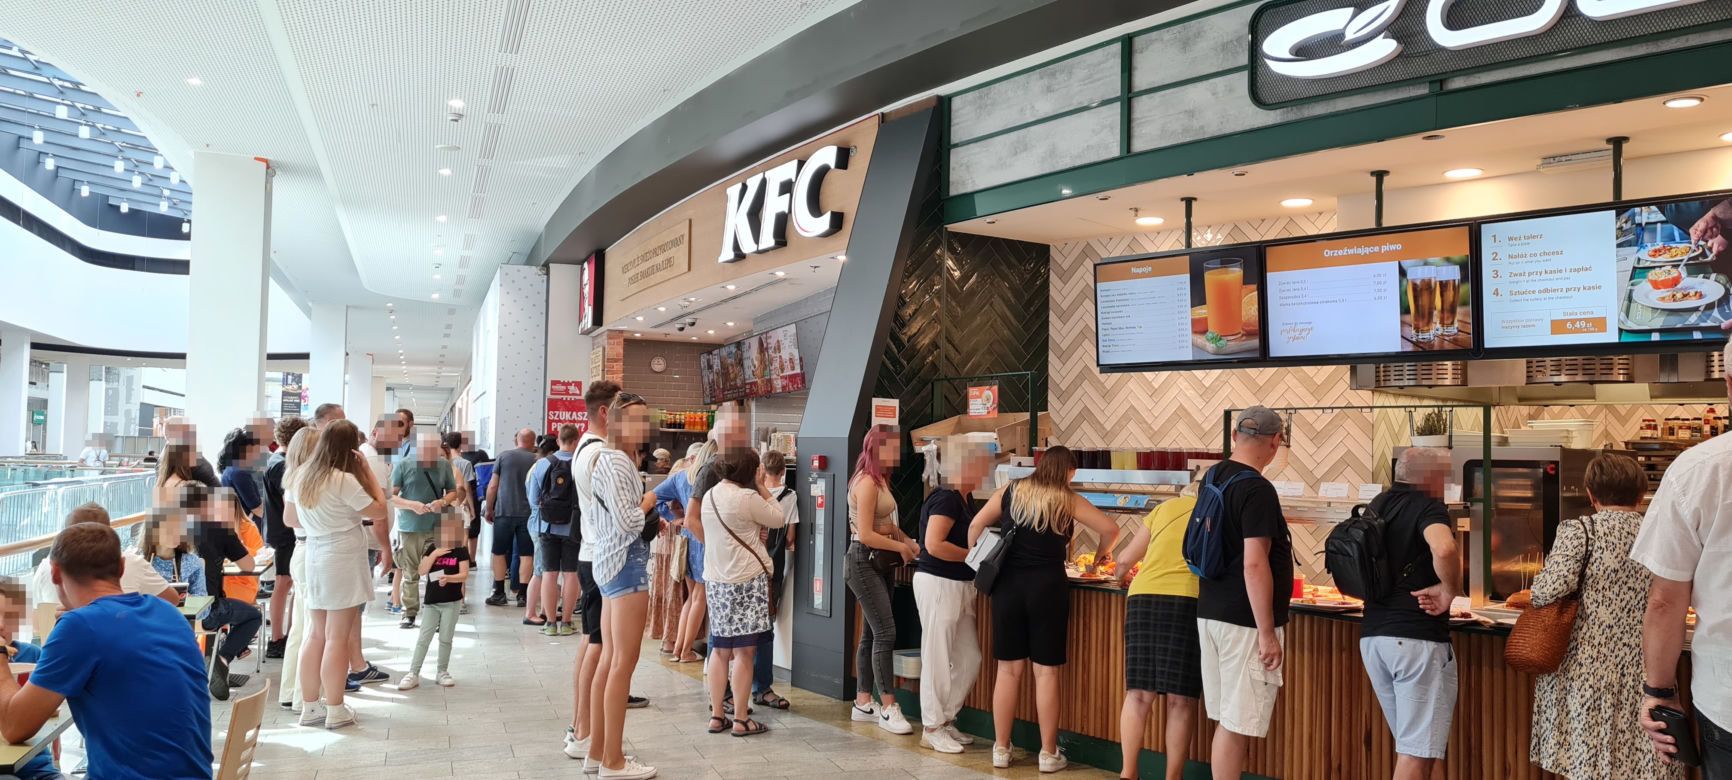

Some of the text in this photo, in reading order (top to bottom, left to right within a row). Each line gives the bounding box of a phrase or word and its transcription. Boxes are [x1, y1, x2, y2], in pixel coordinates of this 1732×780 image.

[718, 145, 846, 264] KFC
[1491, 234, 1502, 244] 1.
[1323, 242, 1402, 258] Orzeźwiające piwo
[1491, 251, 1502, 261] 2.
[1508, 251, 1528, 260] Nałóż
[1539, 249, 1564, 257] chcesz
[1131, 265, 1152, 274] Napoje
[1492, 269, 1503, 279] 3.
[1508, 270, 1526, 278] Zważ
[1527, 269, 1543, 278] przy
[1544, 267, 1563, 275] kasie
[1569, 265, 1593, 274] zapłać
[1492, 283, 1603, 297] 4. Sztućce odbierz przy kasie
[1566, 320, 1586, 331] 6,49
[548, 410, 588, 421] SZUKASZ
